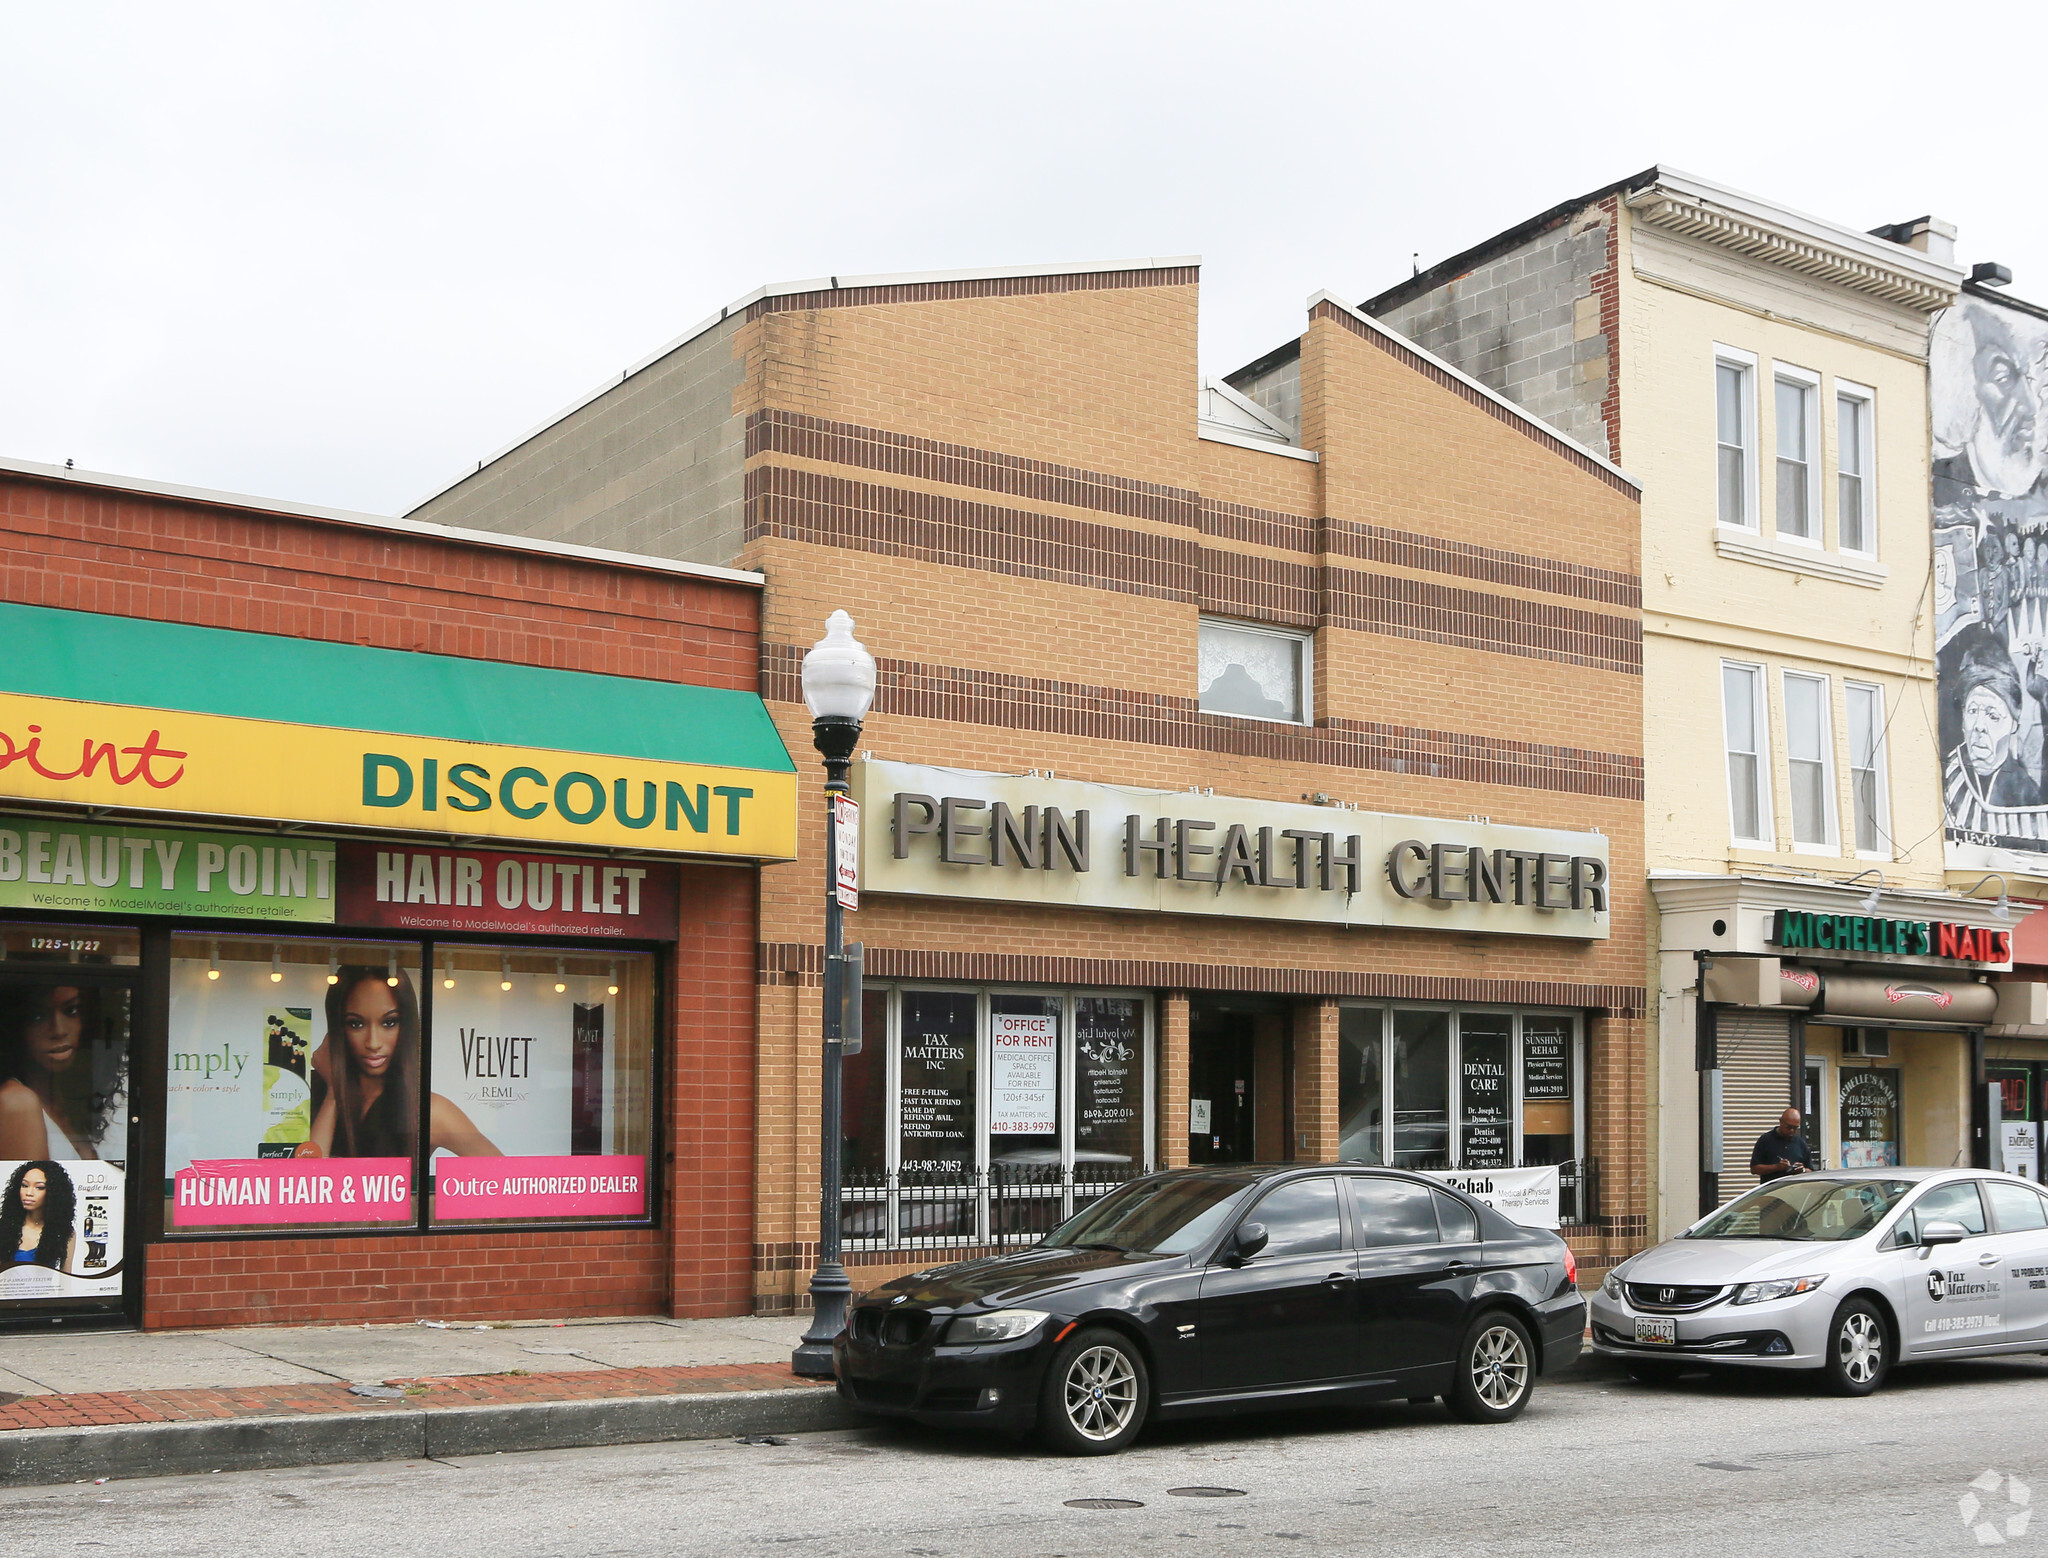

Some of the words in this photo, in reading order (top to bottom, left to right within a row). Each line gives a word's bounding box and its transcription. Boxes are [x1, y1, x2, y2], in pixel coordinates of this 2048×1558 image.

[363, 752, 753, 836] DISCOUNT
[1964, 832, 1998, 846] LEWIS
[892, 792, 1090, 873] PENN
[1125, 814, 1361, 893] HEALTH
[1387, 839, 1608, 912] CENTER
[0, 828, 184, 890] BEAUTY
[196, 842, 336, 899] POINT
[376, 852, 483, 907] HAIR
[496, 859, 646, 915] OUTLET
[33, 893, 90, 907] Welcome
[94, 895, 106, 908] to
[109, 898, 192, 912] ModelModel's
[195, 902, 253, 915] authorized
[256, 905, 297, 918] retailer.
[400, 916, 450, 928] Welcome
[452, 918, 463, 928] to
[465, 920, 536, 932] ModelModel's
[538, 923, 588, 935] authorized
[590, 924, 625, 936] retailer.
[1782, 910, 1928, 956] MICHELLE'S
[1938, 921, 2010, 964] NAILS
[31, 938, 100, 951] 1725-1727
[1003, 1019, 1046, 1031] OFFICE
[923, 1034, 949, 1046] TAX
[996, 1035, 1020, 1046] FOR
[1023, 1036, 1053, 1047] RENT
[1525, 1036, 1563, 1045] SUNSHINE
[459, 1028, 532, 1080] VELVET
[904, 1047, 964, 1059] MATTERS
[1531, 1046, 1558, 1055] REHAB
[168, 1043, 250, 1079] mply
[926, 1061, 946, 1070] INC.
[1464, 1063, 1505, 1076] DENTAL
[193, 1084, 213, 1092] color
[222, 1084, 240, 1093] style
[1023, 1080, 1040, 1088] RENT
[1470, 1078, 1498, 1091] CARE
[270, 1089, 303, 1101] simply
[482, 1087, 512, 1098] REMI
[1003, 1093, 1045, 1102] 120sf-345sf
[1478, 1107, 1494, 1115] Joseph
[992, 1122, 1055, 1132] 410-383-9979
[903, 1130, 944, 1138] ANTICIPATED
[1467, 1147, 1496, 1156] Emergency
[180, 1176, 270, 1207] HUMAN
[278, 1176, 333, 1205] HAIR
[340, 1176, 356, 1204] &
[361, 1174, 406, 1203] WIG
[442, 1177, 498, 1197] Outre
[502, 1175, 587, 1195] AUTHORIZED
[590, 1175, 638, 1194] DEALER
[1528, 1188, 1551, 1197] Physical
[1502, 1199, 1524, 1208] Therapy
[1524, 1198, 1549, 1206] Services
[1947, 1271, 1965, 1282] Tax
[1947, 1283, 1985, 1296] Matters
[1987, 1280, 2000, 1292] Inc.
[1925, 1319, 1936, 1332] Call
